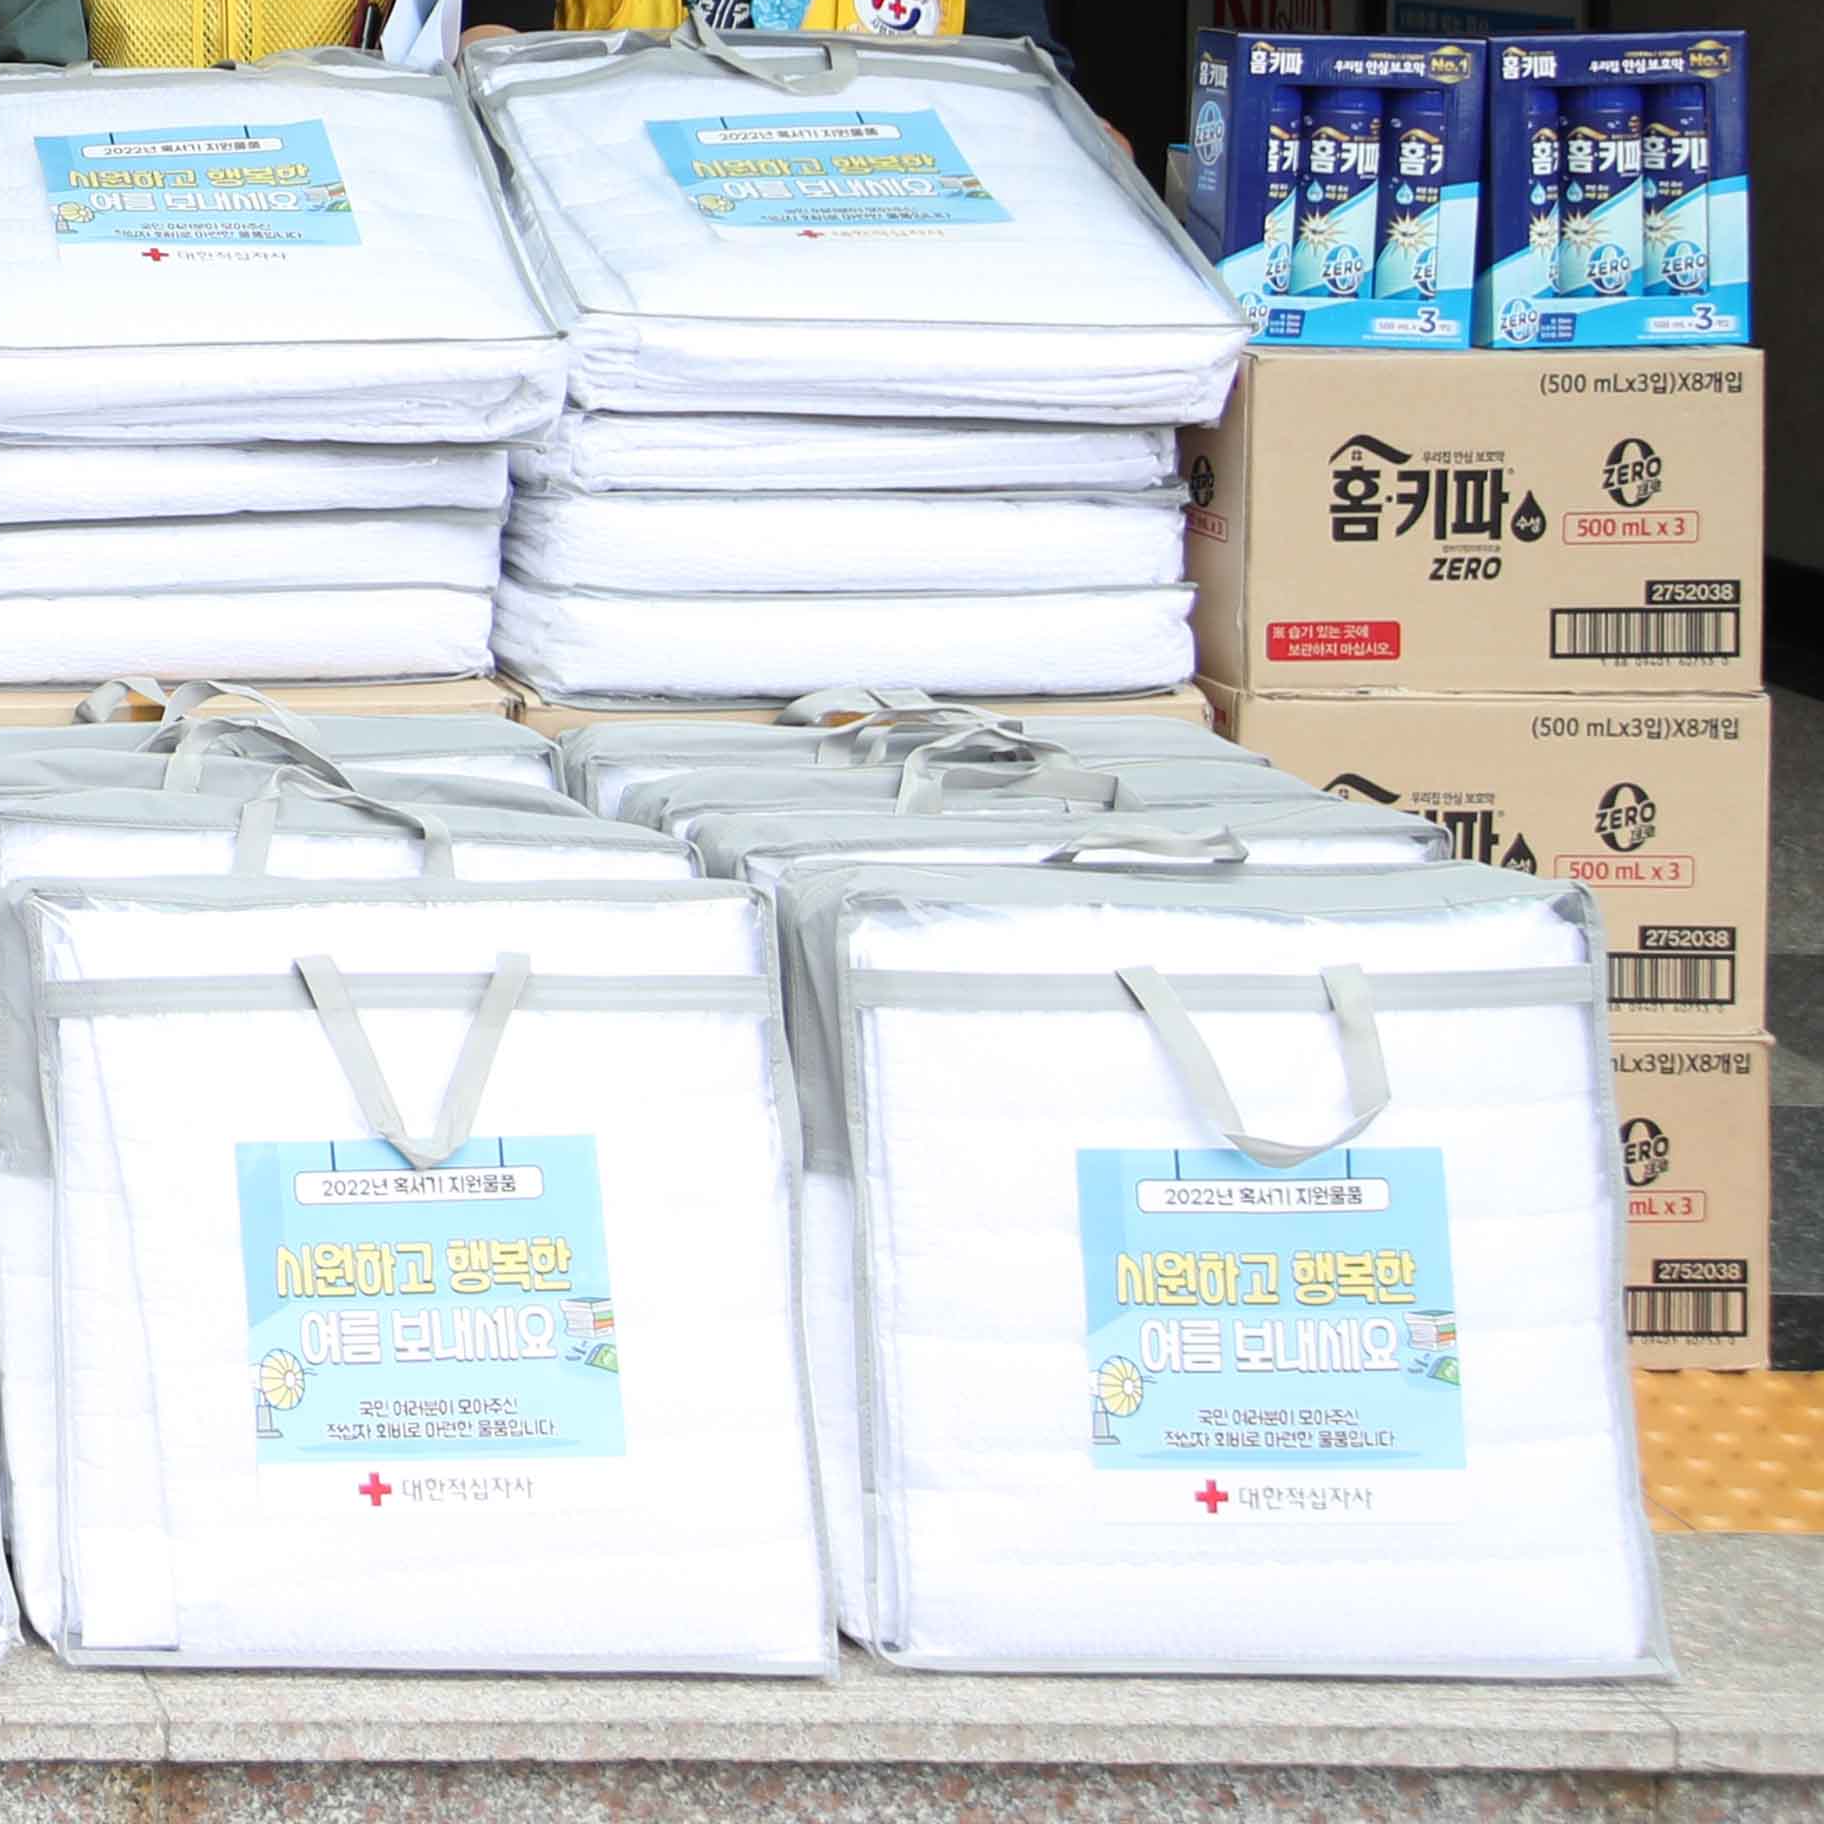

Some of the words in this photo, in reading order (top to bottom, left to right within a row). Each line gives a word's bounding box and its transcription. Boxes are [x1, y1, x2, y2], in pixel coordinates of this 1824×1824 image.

[1431, 57, 1468, 72] No.1
[1689, 53, 1728, 67] No.1
[1501, 310, 1538, 330] ZERO
[1695, 306, 1713, 330] 3
[1539, 373, 1587, 396] (500
[1593, 371, 1743, 396] mLx3입)X8개입
[1602, 456, 1662, 490] ZERO
[1429, 556, 1502, 581] ZERO
[1651, 583, 1734, 602] 2752038
[1646, 929, 1729, 947] 2752038
[1624, 1136, 1669, 1164] ERO
[276, 1242, 436, 1298] 시원하고
[446, 1236, 572, 1294] 행복한
[1116, 1252, 1280, 1306] 시원하고
[1292, 1250, 1417, 1305] 행복한
[1659, 1263, 1741, 1280] 2752038
[301, 1309, 382, 1365] 여름
[392, 1305, 558, 1362] 보내세요
[1140, 1319, 1223, 1373] 여름
[1234, 1318, 1401, 1373] 보내세요
